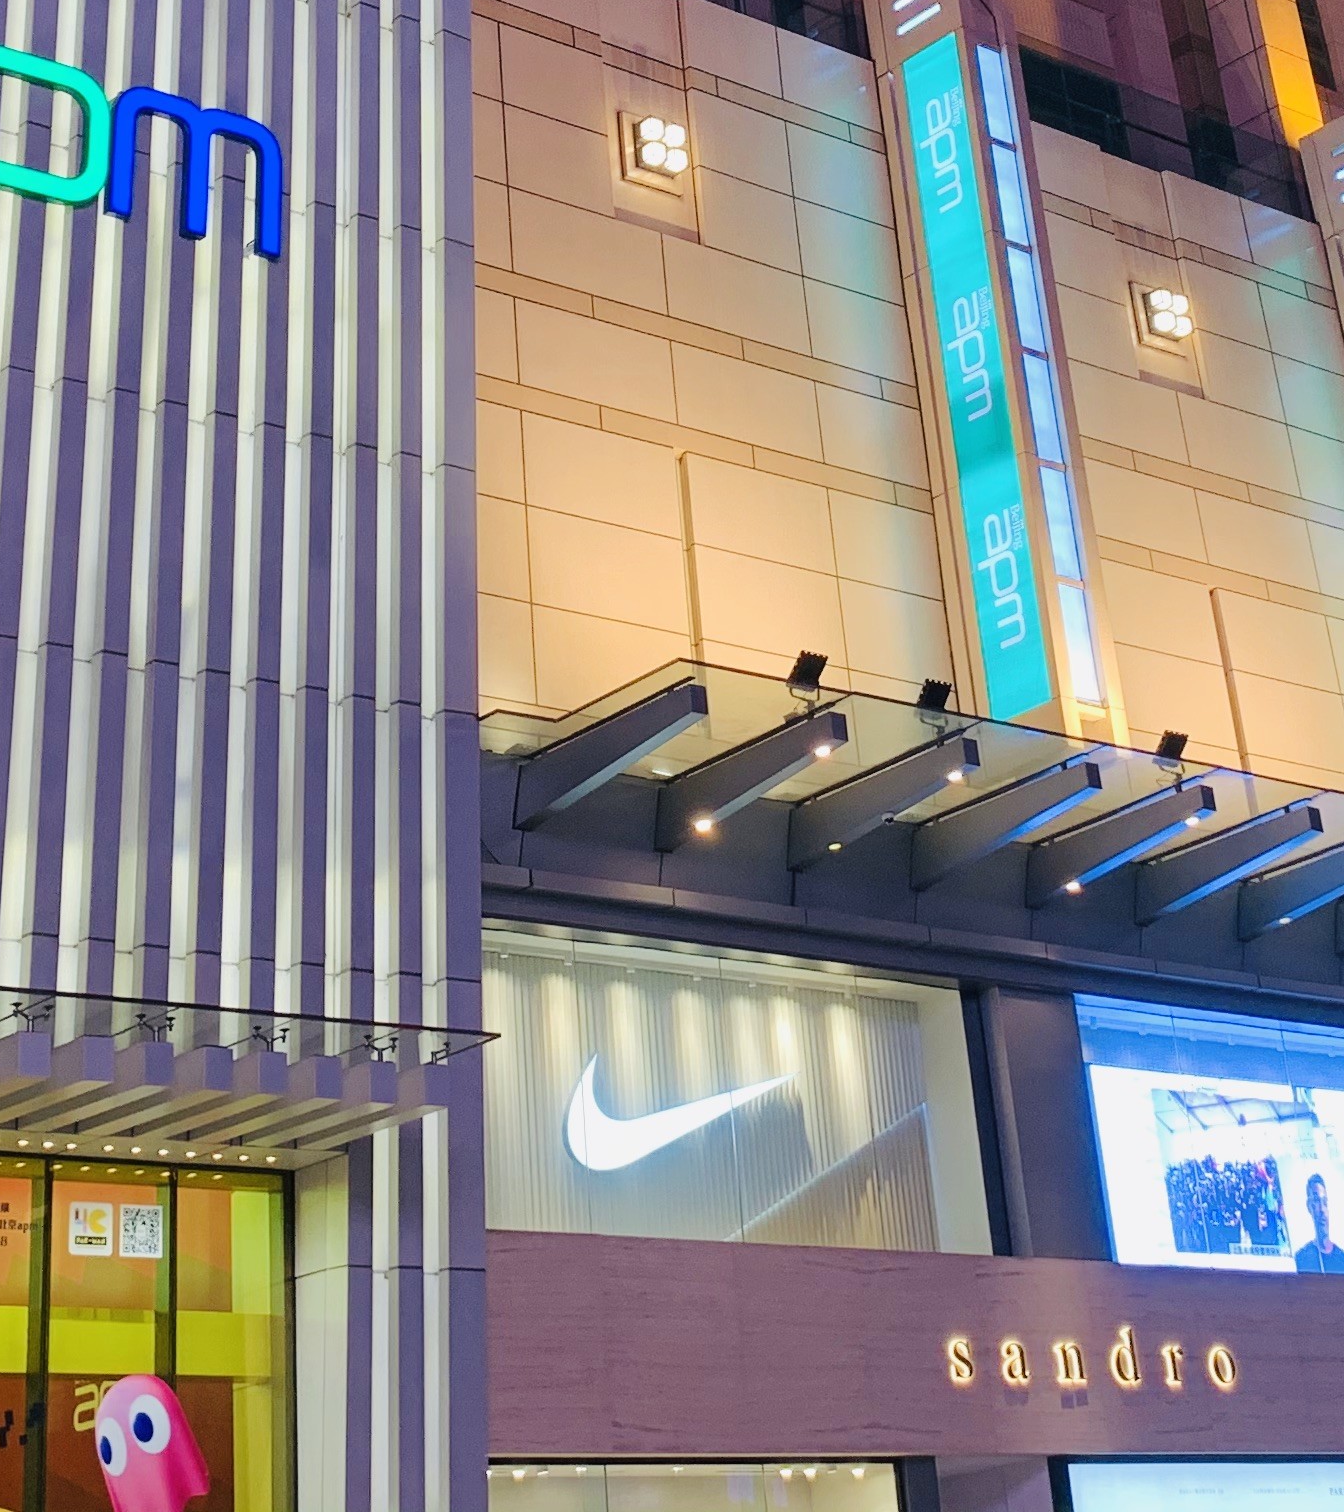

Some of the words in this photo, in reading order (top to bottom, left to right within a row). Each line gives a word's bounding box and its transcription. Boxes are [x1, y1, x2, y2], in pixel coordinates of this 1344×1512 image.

[920, 91, 963, 214] apm
[947, 291, 993, 422] apm
[978, 508, 1026, 649] apm
[947, 1324, 1238, 1388] sandro
